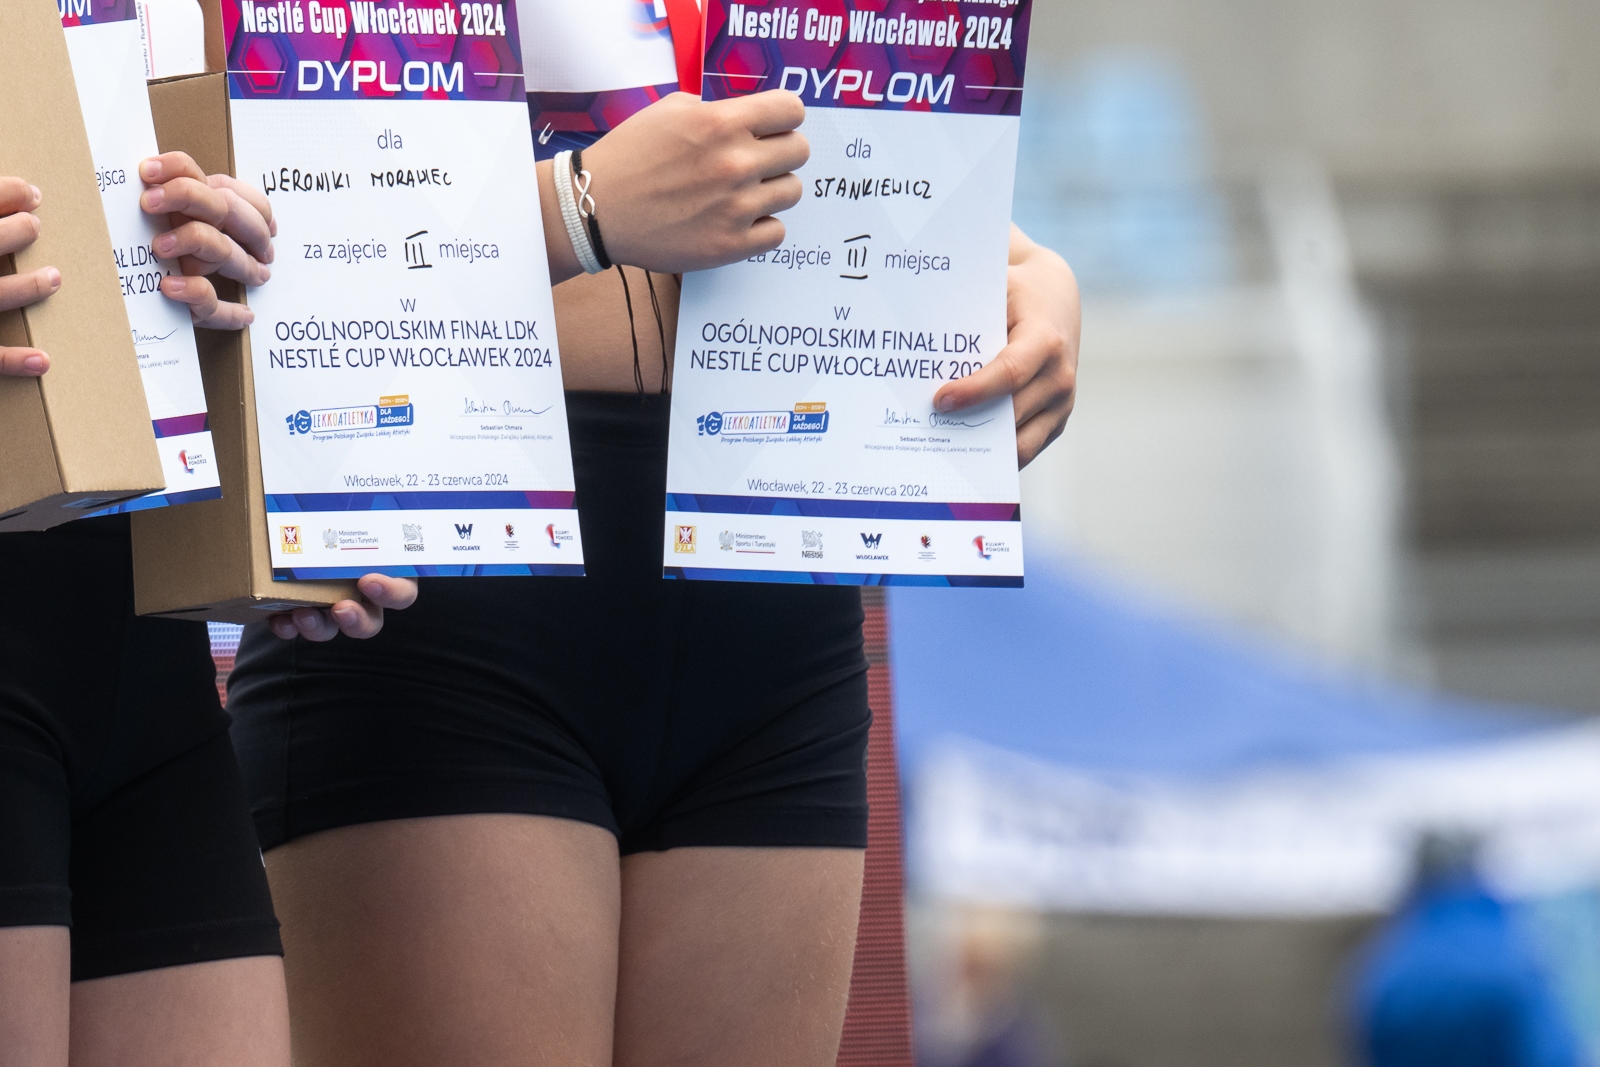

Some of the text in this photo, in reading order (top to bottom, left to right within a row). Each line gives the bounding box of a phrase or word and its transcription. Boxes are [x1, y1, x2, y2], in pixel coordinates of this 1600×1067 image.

[242, 0, 506, 39] Nestlé Cup Włocławek 2024
[728, 3, 1013, 50] Nestlé Cup Włocławek 2024
[297, 60, 464, 92] DYPLOM
[779, 66, 955, 105] DYPLOM
[377, 128, 403, 150] dla
[846, 138, 872, 159] dla
[262, 167, 452, 195] WERONIKI MORAWEC
[815, 178, 932, 200] STANKIEWICZ
[304, 244, 323, 259] za
[329, 238, 387, 264] zajęcie
[439, 238, 500, 264] miejsca
[771, 244, 831, 270] zajęcie
[885, 251, 951, 275] miejsca
[275, 315, 538, 341] OGÓLNOPOLSKIM FINAŁ LDK
[702, 318, 981, 354] OGÓLNOPOLSKIM FINAŁ LDK
[269, 343, 553, 369] NESTLÉ CUP WŁOCŁAWEK 2024
[691, 347, 943, 380] NESTLÉ CUP WŁOCŁAWEK
[313, 410, 374, 428] LEKKOATLETYKA
[723, 416, 787, 430] LEKKOATLETYKA
[343, 474, 509, 488] Włocławek, 22 23 czerwca 2024
[747, 479, 928, 496] Włocławek, 22 23 czerwca 2024
